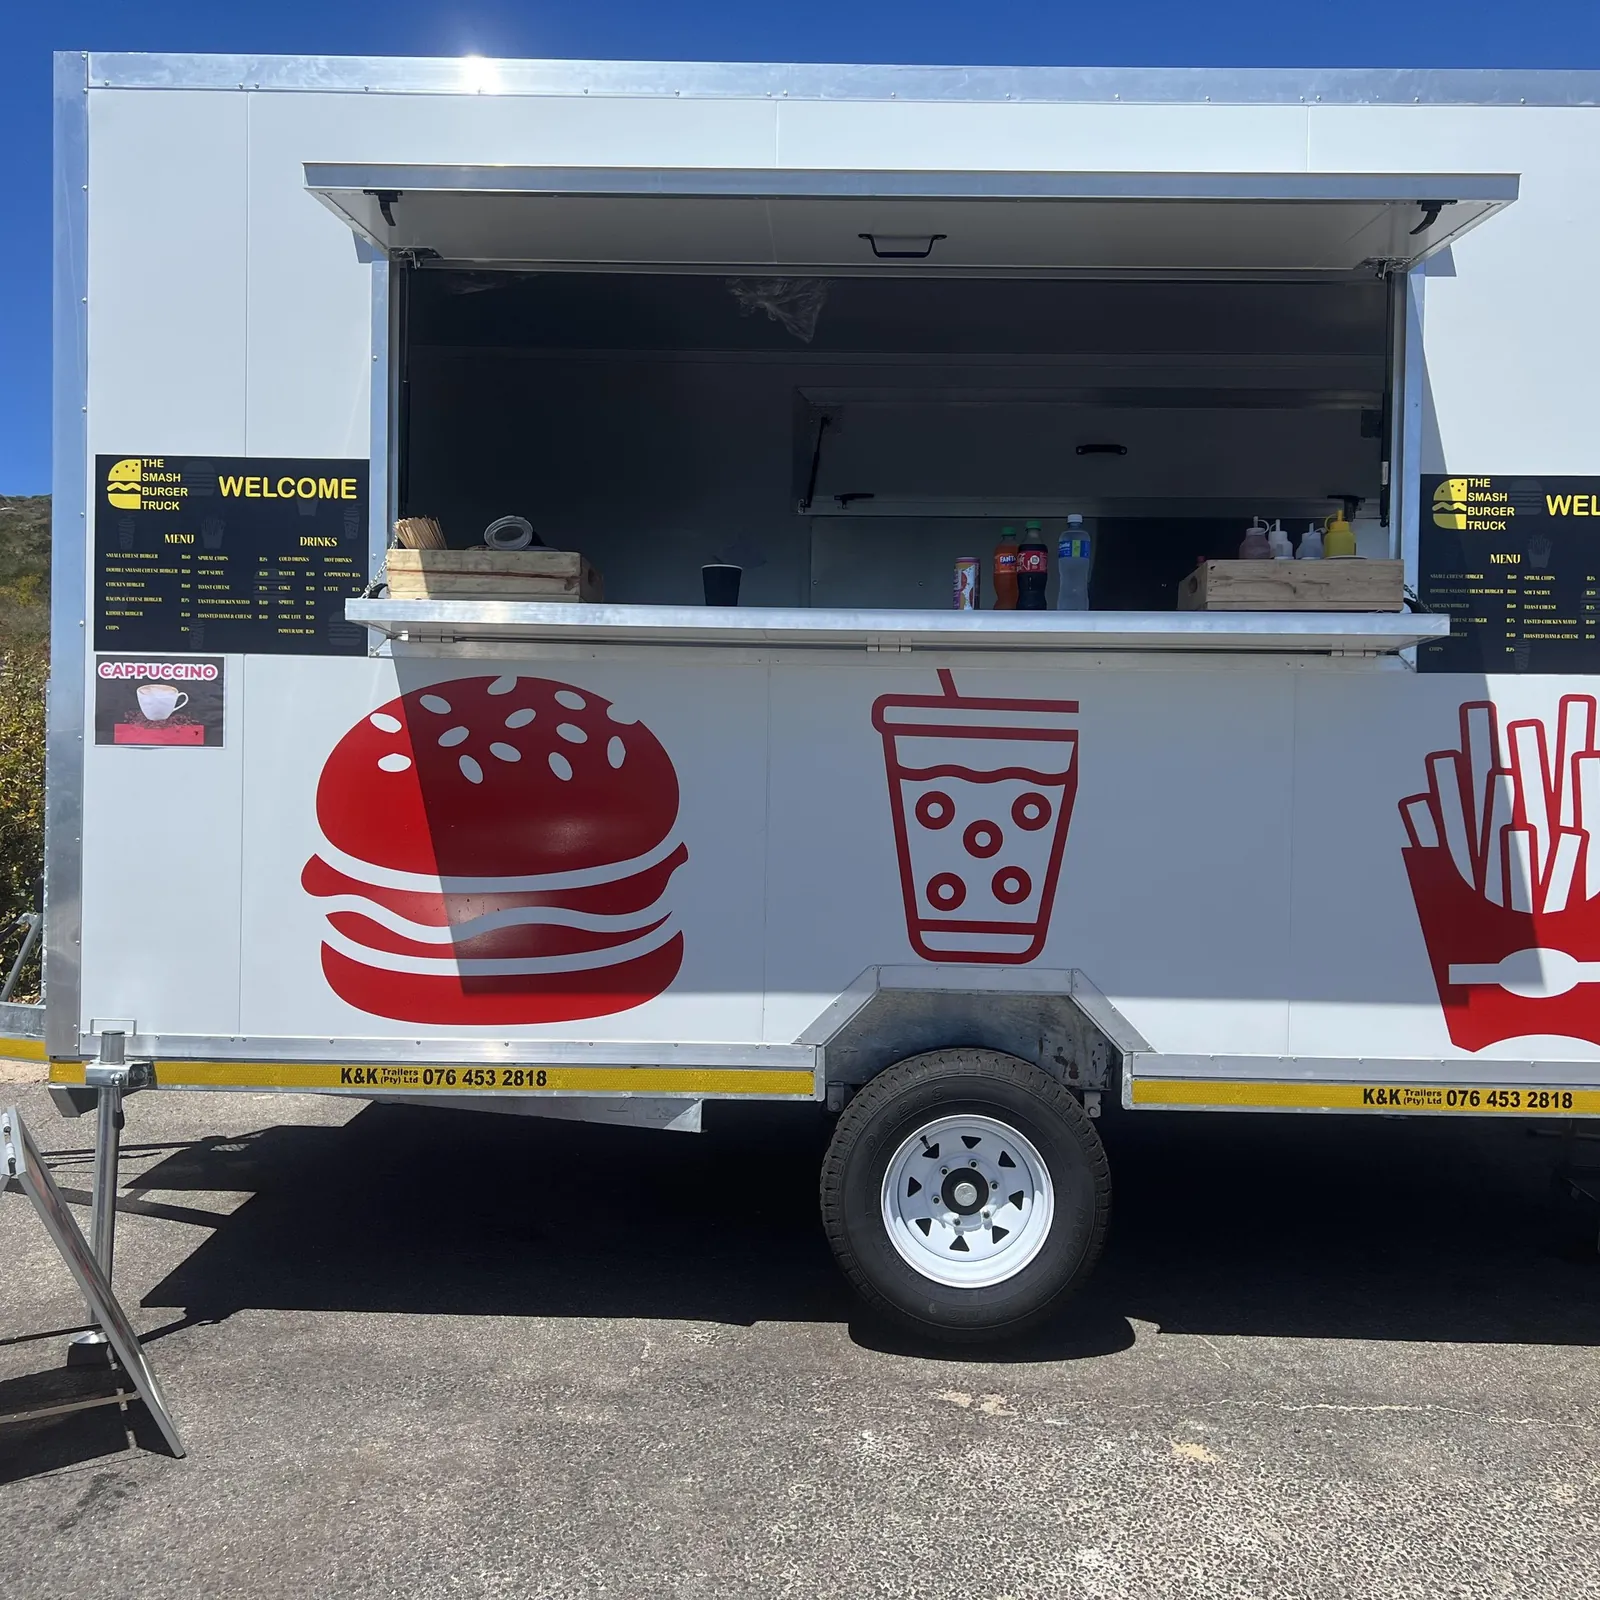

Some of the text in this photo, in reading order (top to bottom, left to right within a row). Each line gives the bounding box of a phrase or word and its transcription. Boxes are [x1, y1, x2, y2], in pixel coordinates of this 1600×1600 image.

[142, 459, 164, 468] THE
[142, 473, 181, 482] SMASH
[218, 475, 357, 500] WELCOME
[1468, 478, 1491, 488] THE
[142, 486, 188, 497] BURGER
[1468, 493, 1508, 502] SMASH
[142, 500, 180, 511] TRUCK
[1468, 506, 1515, 516] BURGER
[1467, 521, 1506, 530] TRUCK
[164, 533, 194, 544] MENU
[300, 536, 338, 547] DRINKS
[1490, 554, 1521, 564] MENU
[99, 662, 218, 681] CAPPUCCINO
[341, 1067, 547, 1086] K&K 076 453 2818
[382, 1068, 418, 1076] Trailers
[380, 1076, 418, 1084] (Pty) Ltd
[1404, 1088, 1442, 1097] Trailers
[1363, 1088, 1573, 1108] K&K 076 453 2818
[1404, 1097, 1424, 1105] (Pty)
